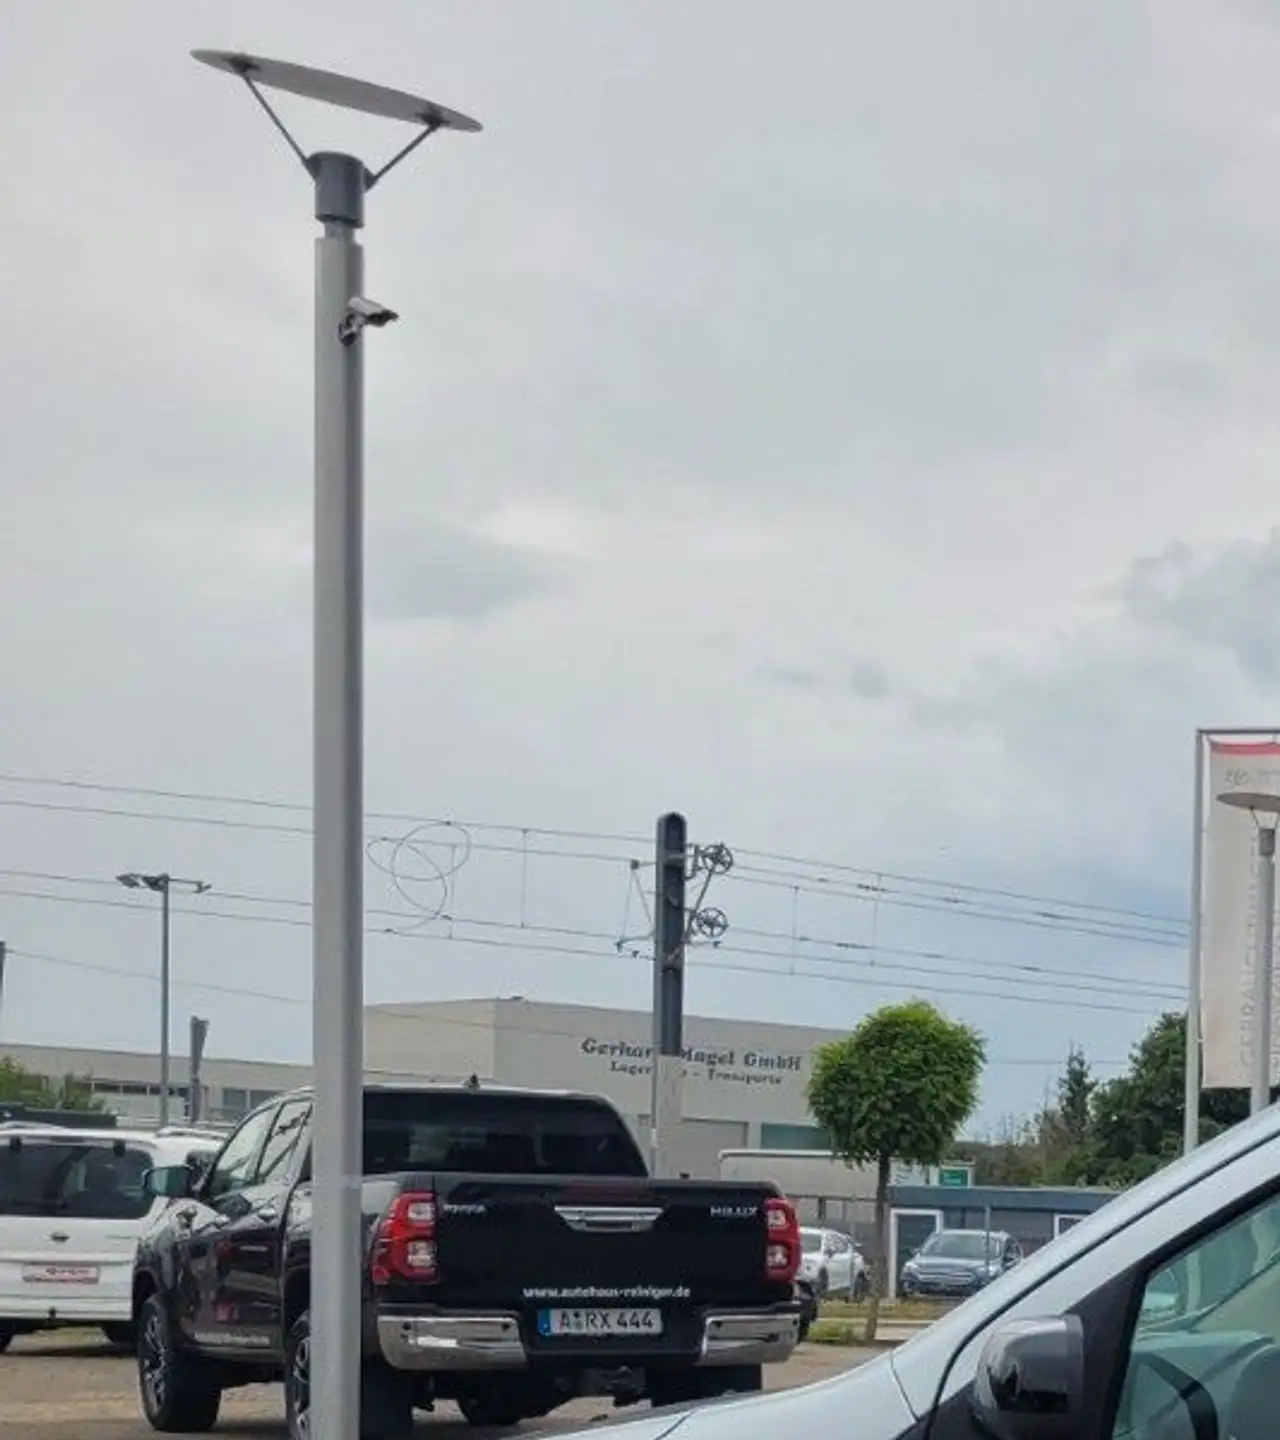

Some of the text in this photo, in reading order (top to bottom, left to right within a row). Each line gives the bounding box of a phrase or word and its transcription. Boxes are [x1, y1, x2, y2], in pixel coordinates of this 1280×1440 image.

[581, 1037, 652, 1059] Gerhar
[744, 1051, 801, 1071] GmbH
[585, 1311, 611, 1330] RX
[616, 1310, 655, 1329] 444
